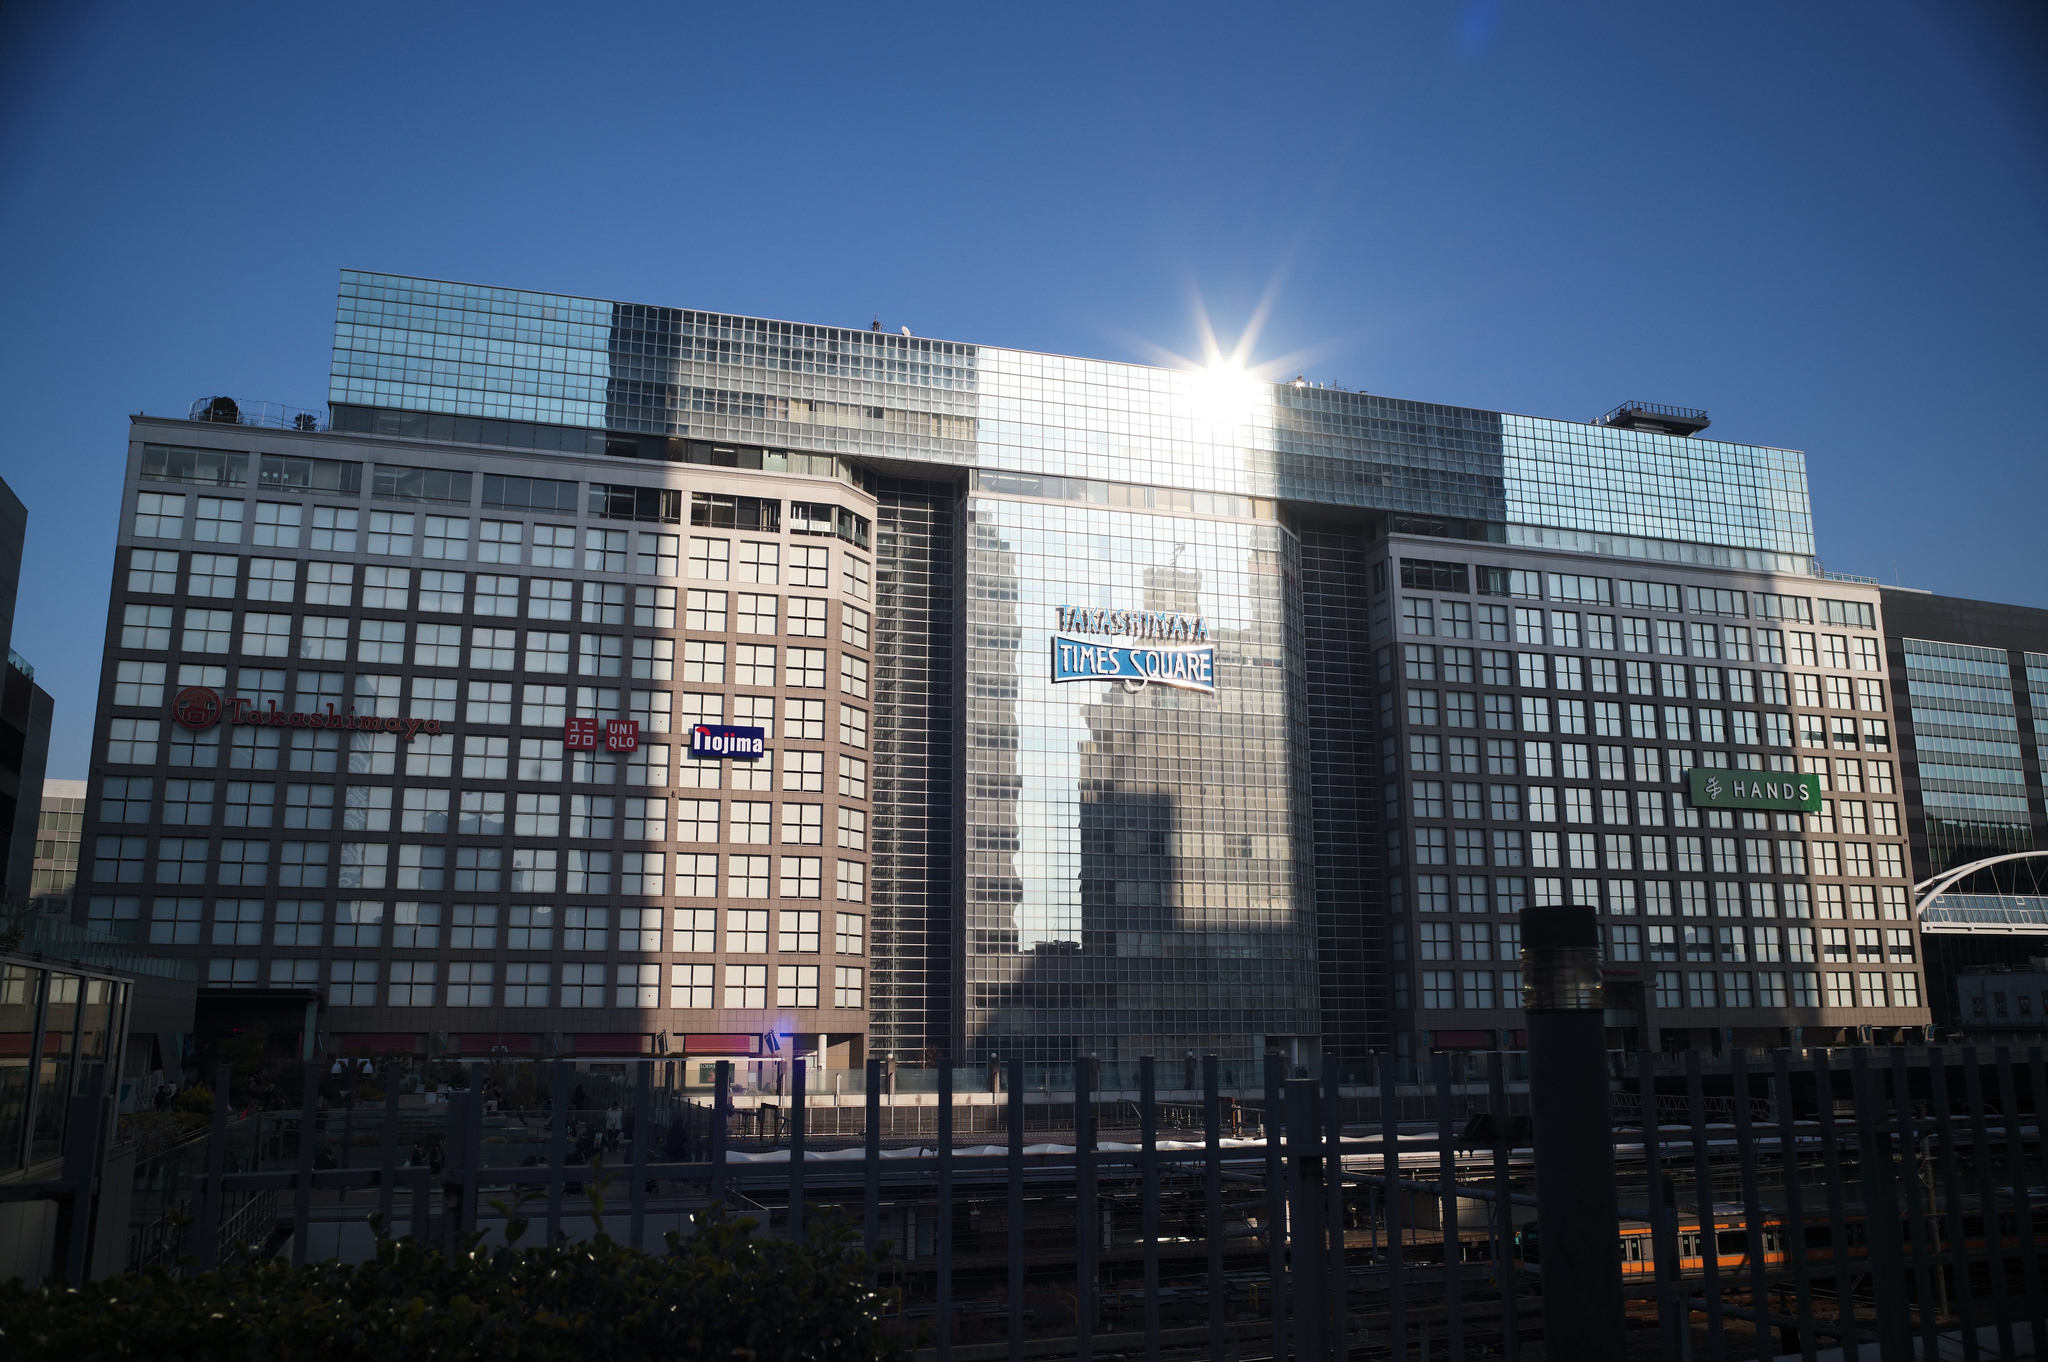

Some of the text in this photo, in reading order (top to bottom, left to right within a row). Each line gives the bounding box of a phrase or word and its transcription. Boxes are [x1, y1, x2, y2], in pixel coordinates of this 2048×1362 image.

[1060, 604, 1209, 639] TAKASHIMAYA
[1060, 644, 1212, 691] TIMES SQUARE
[225, 698, 442, 741] Takashimaya
[569, 721, 594, 733] ユニ
[609, 723, 633, 735] UNI
[568, 734, 594, 746] クロ
[609, 736, 634, 749] QLO
[694, 726, 763, 754] nojima
[1732, 780, 1810, 801] HANDS
